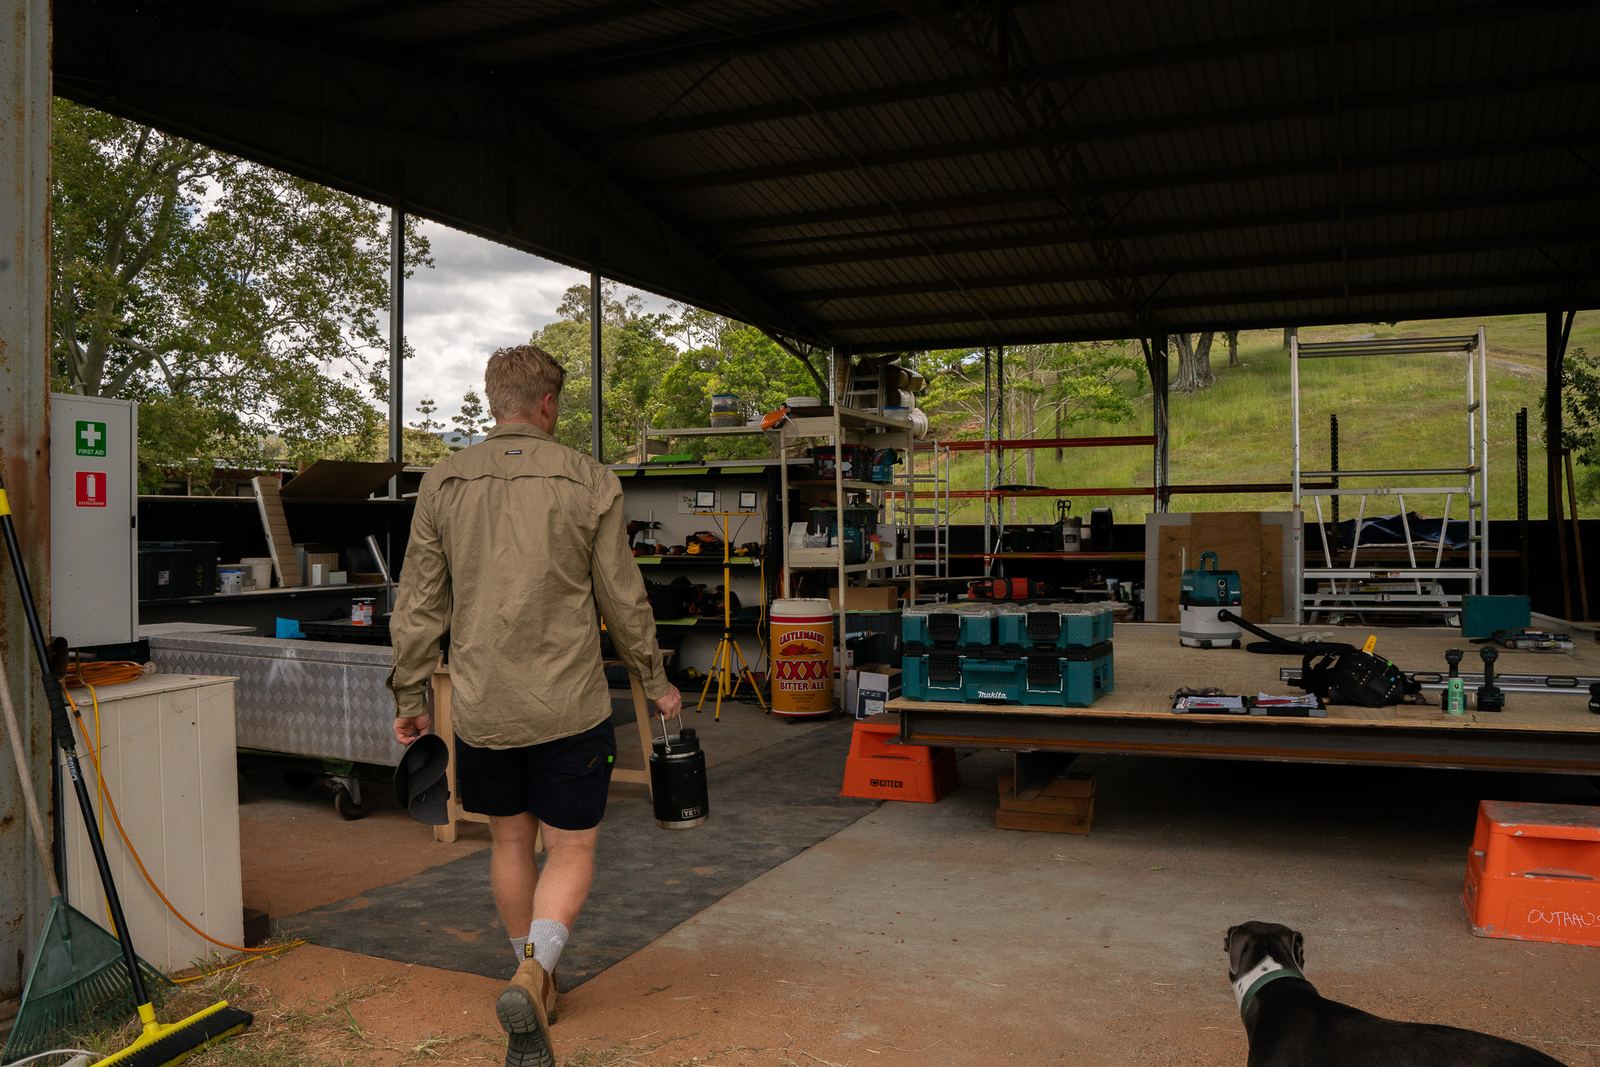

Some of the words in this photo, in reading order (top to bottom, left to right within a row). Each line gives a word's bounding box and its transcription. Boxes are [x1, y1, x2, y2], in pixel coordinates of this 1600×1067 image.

[775, 660, 829, 680] XXXX
[780, 682, 808, 691] BITTER
[811, 682, 825, 690] ALE
[977, 690, 1008, 699] Makita
[880, 779, 903, 789] CITECO
